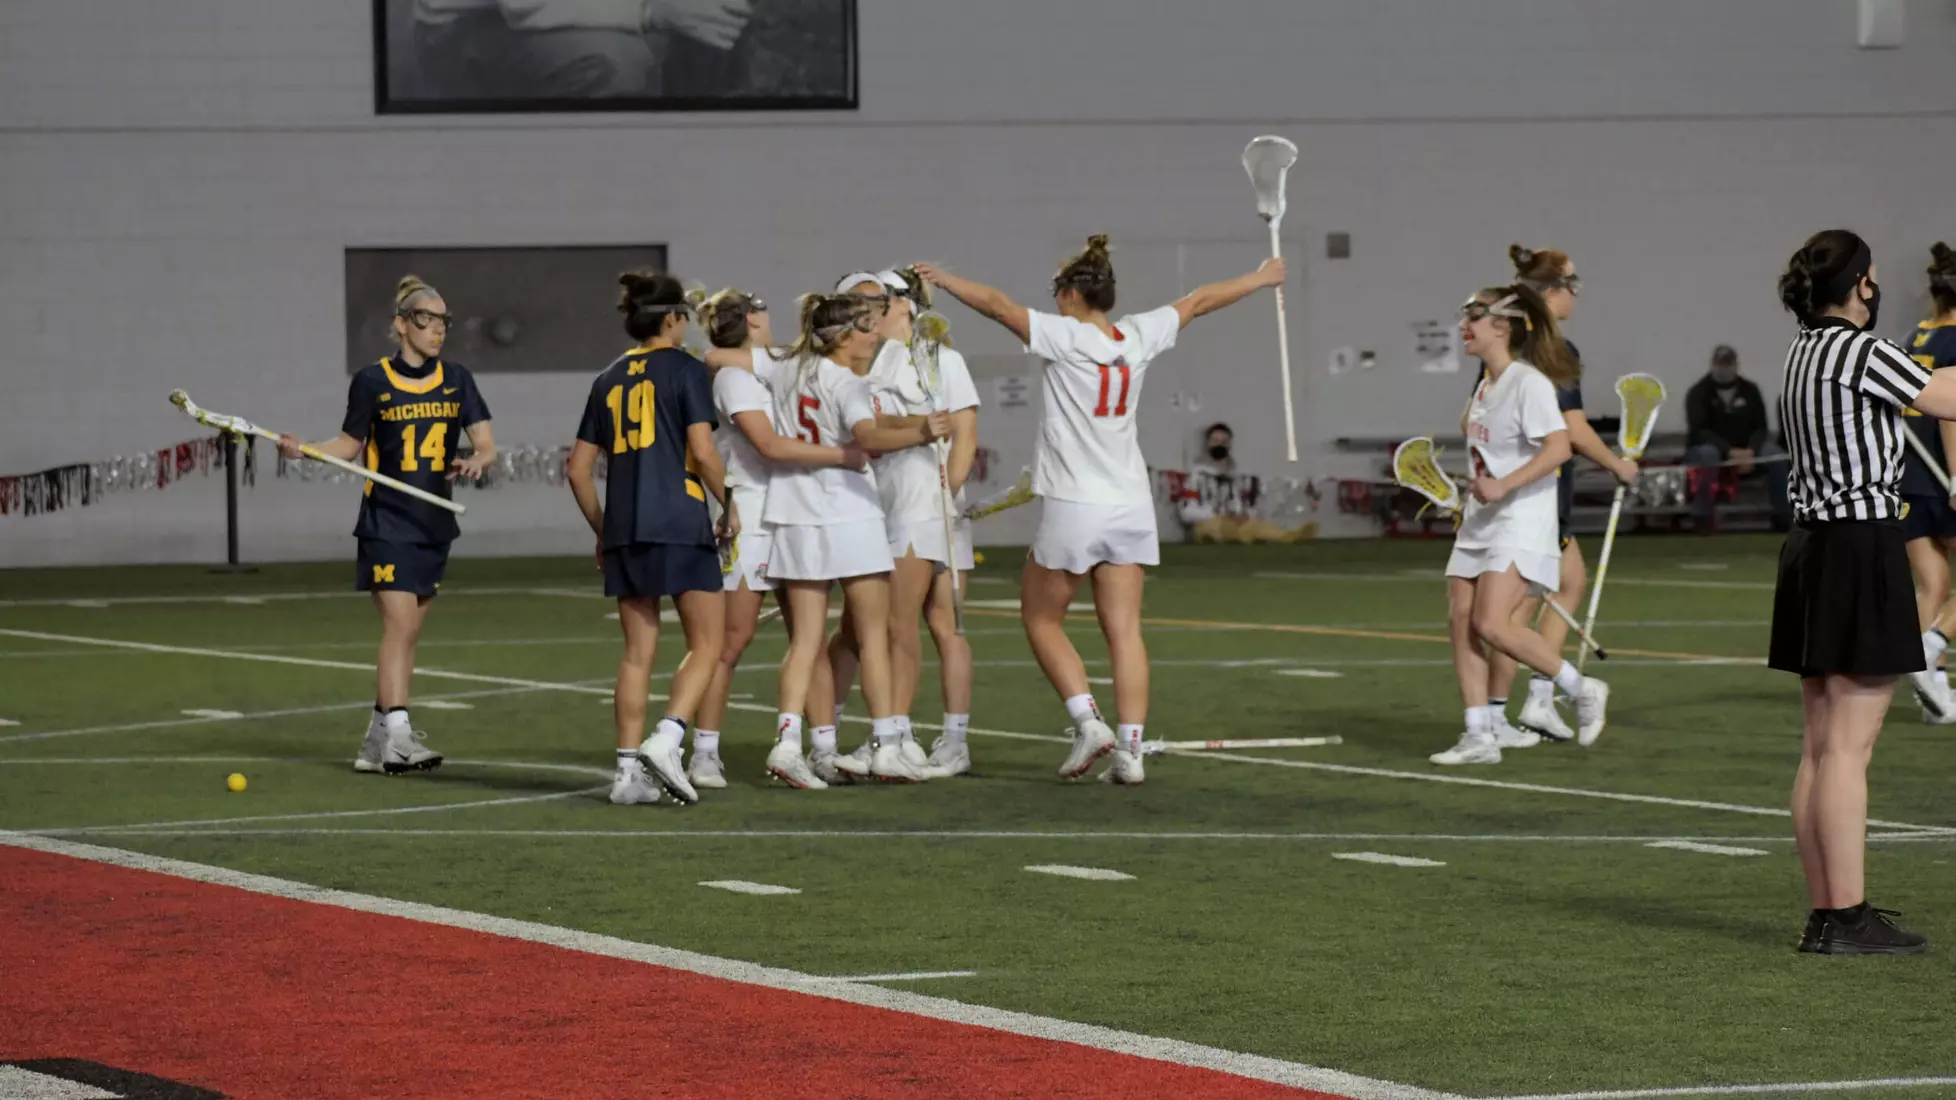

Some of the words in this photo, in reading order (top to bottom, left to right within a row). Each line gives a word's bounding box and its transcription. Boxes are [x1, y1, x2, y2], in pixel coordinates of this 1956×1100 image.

[627, 359, 648, 376] M
[1094, 365, 1130, 417] 11
[380, 401, 460, 421] MICHIGAN
[606, 379, 655, 454] 19
[401, 422, 448, 472] 14
[373, 564, 395, 583] M
